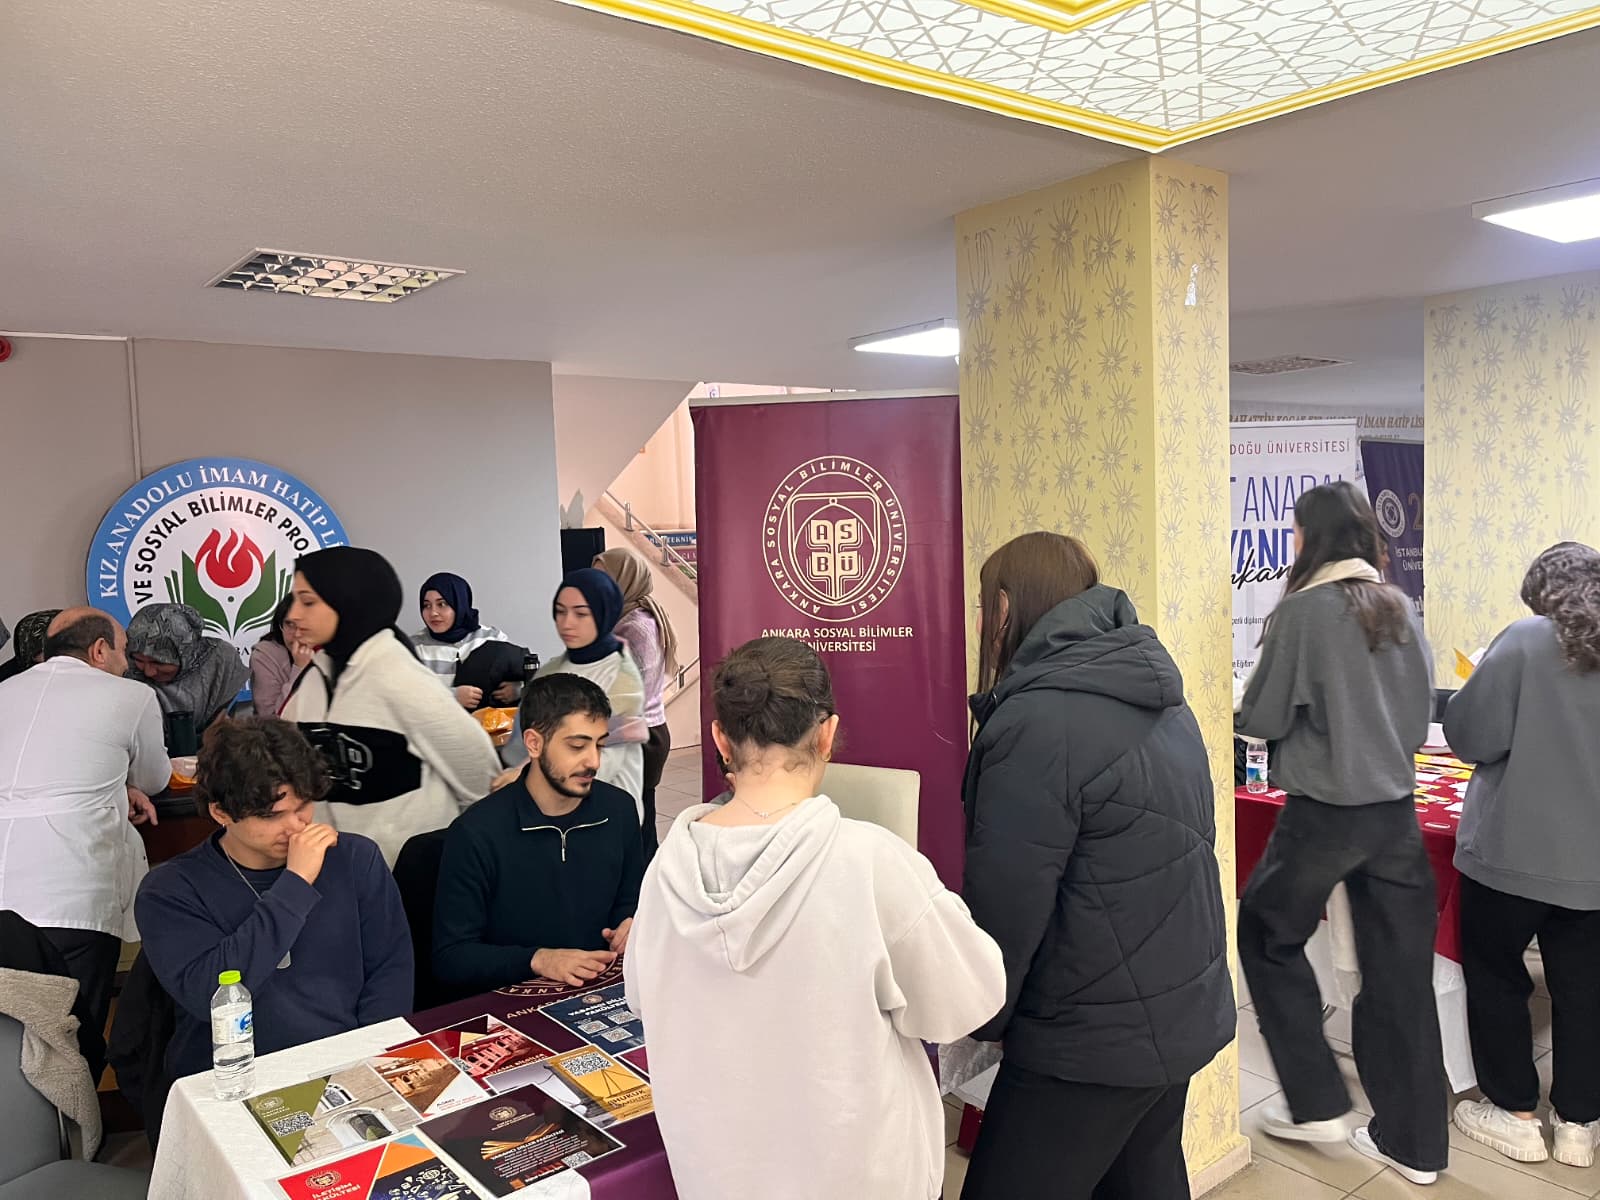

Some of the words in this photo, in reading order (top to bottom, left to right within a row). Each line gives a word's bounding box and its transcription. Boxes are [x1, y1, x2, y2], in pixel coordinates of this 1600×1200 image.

[1411, 414, 1424, 428] LİS
[1267, 438, 1350, 454] ÜNİVERSİTESİ
[199, 465, 269, 490] İMAM
[799, 458, 883, 491] BİLİMLER
[106, 472, 194, 555] ANADOLU
[187, 491, 279, 524] BİLİMLER
[272, 479, 329, 527] HATİP
[767, 483, 794, 548] SOSYAL
[134, 510, 187, 573] SOSYAL
[278, 517, 309, 560] PRO
[851, 498, 904, 615] ÜNİVERSİTESİ
[100, 558, 119, 598] KIZ
[133, 580, 153, 604] VE
[771, 558, 821, 614] ANKARA
[761, 628, 811, 638] ANKARA
[813, 627, 856, 639] SOSYAL
[859, 625, 914, 638] BİLİMLER
[799, 639, 876, 652] NİVERSİTESİ
